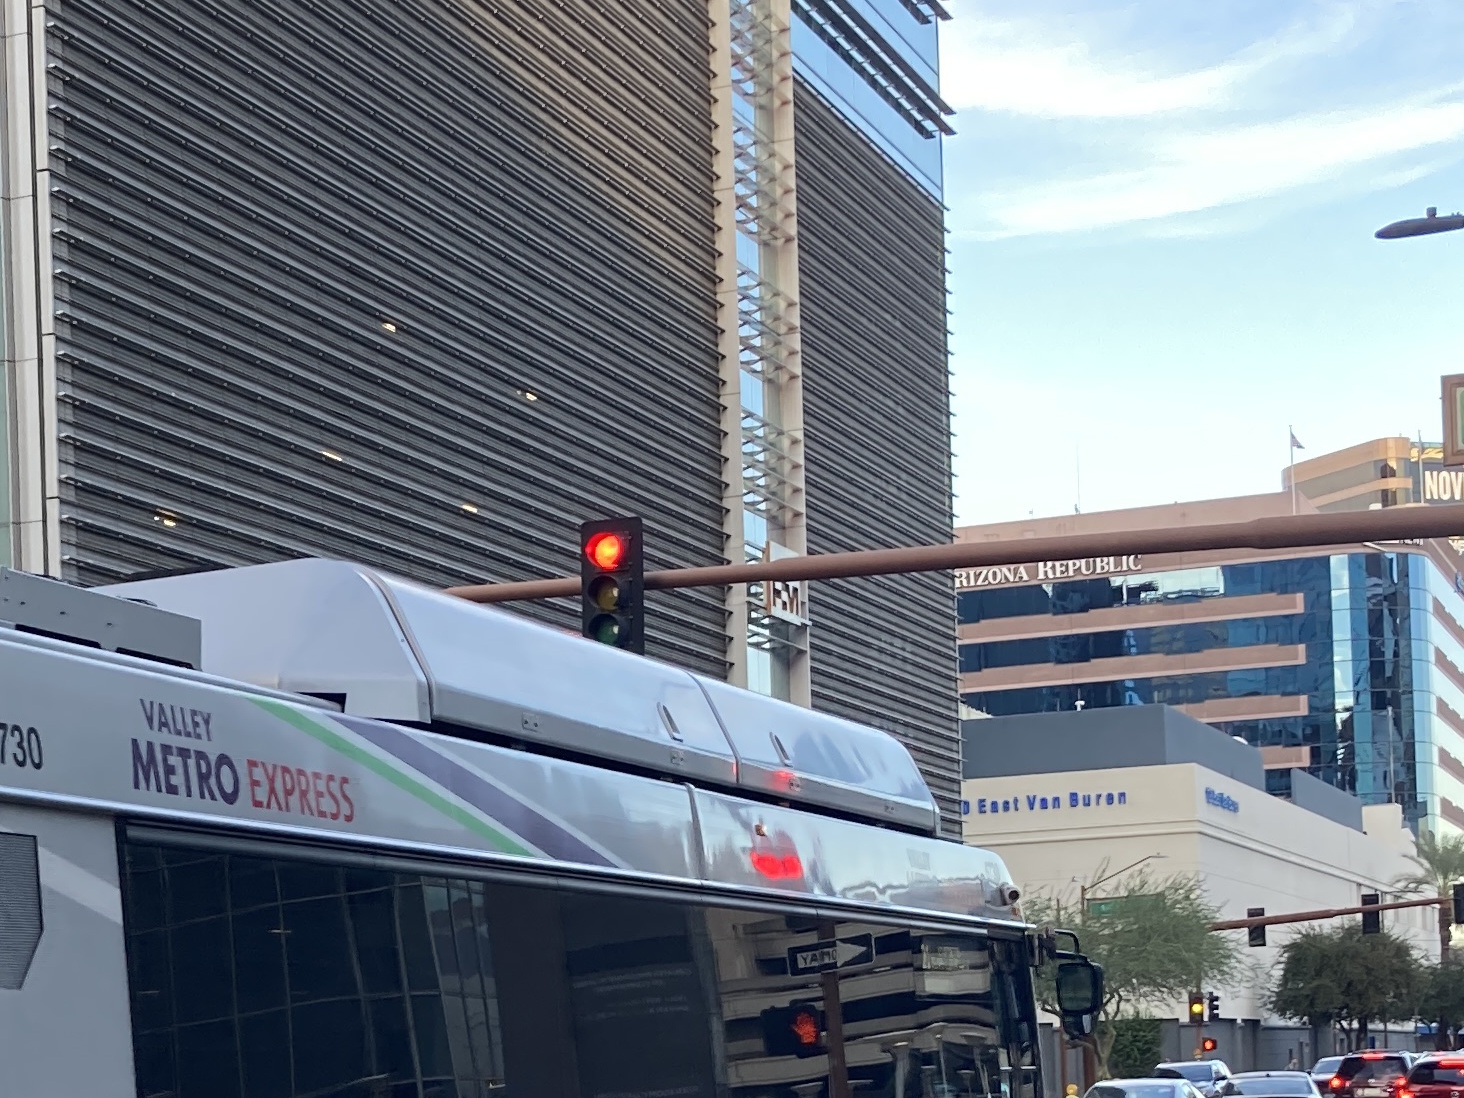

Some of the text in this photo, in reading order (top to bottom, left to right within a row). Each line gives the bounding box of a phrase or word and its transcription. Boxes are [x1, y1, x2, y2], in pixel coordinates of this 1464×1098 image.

[1425, 470, 1464, 501] NOV
[955, 554, 1143, 587] RIZONA REPUBLIC
[138, 698, 213, 743] VALLEY
[132, 737, 356, 823] METRO EXPRESS
[978, 796, 1019, 814] East
[1026, 794, 1061, 811] Van
[1069, 791, 1127, 808] Buren
